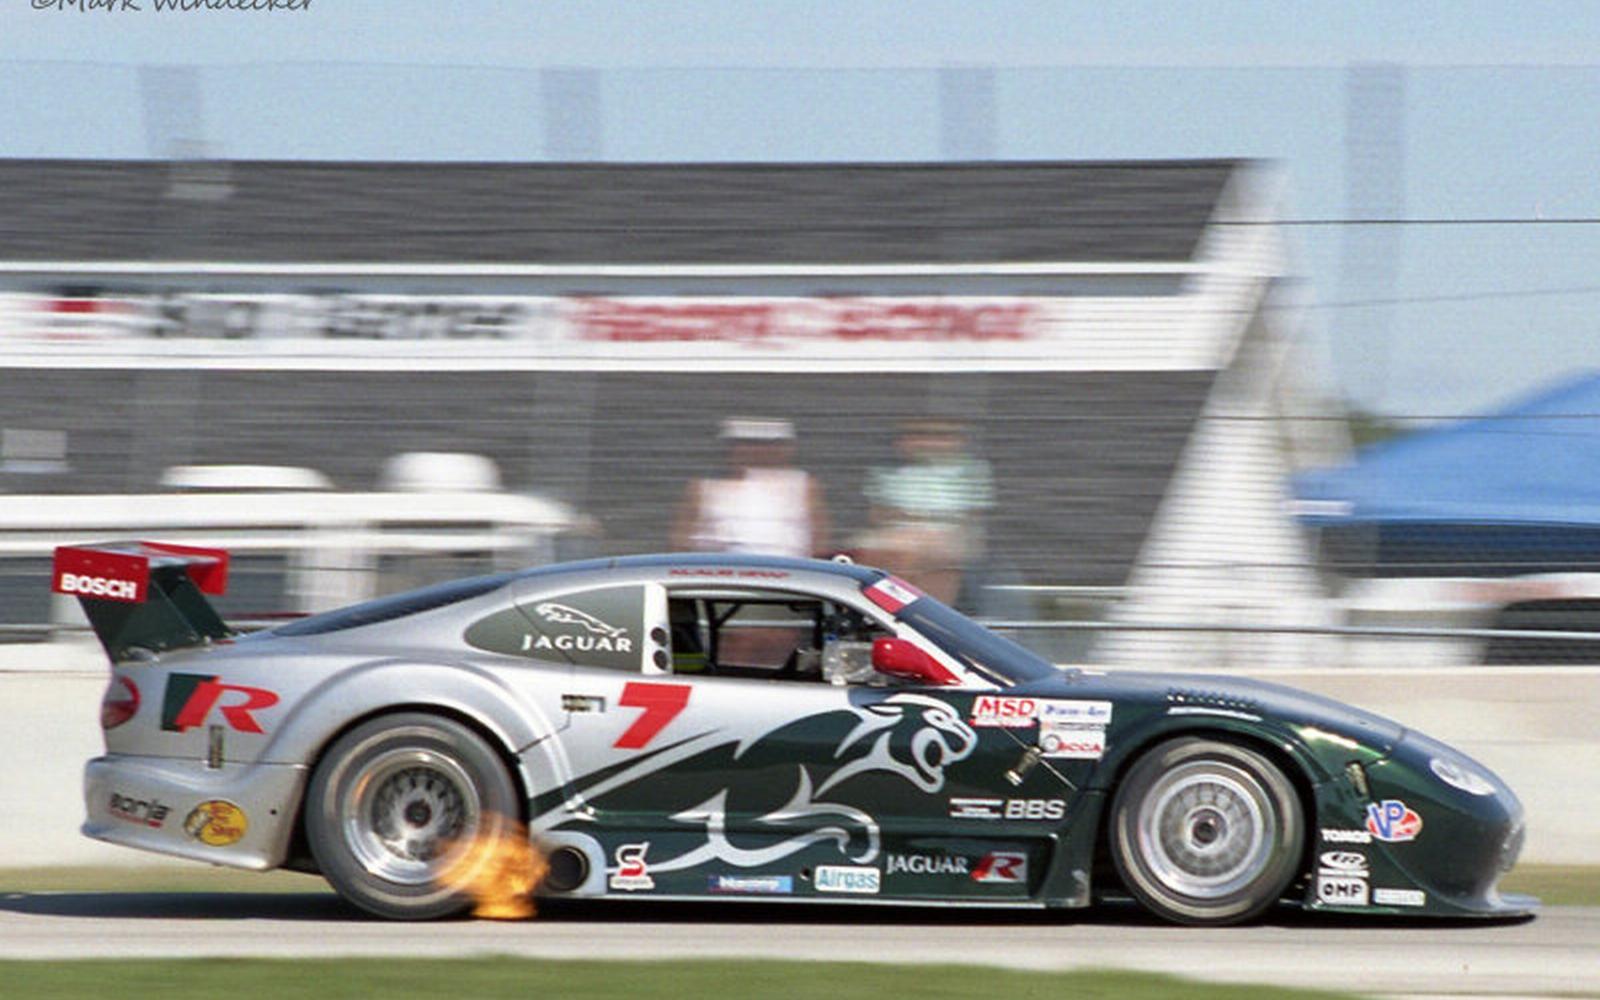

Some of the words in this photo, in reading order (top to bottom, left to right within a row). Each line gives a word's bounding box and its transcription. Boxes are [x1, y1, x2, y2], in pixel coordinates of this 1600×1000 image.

[60, 572, 137, 600] BOSCH
[521, 633, 633, 654] JAGUAR
[612, 681, 692, 750] 7
[977, 699, 1036, 717] MSD
[1004, 800, 1067, 819] BBS
[1366, 800, 1406, 840] VP
[885, 854, 969, 875] JAGUAR
[817, 869, 877, 889] Airgas
[1323, 882, 1363, 897] OMP
